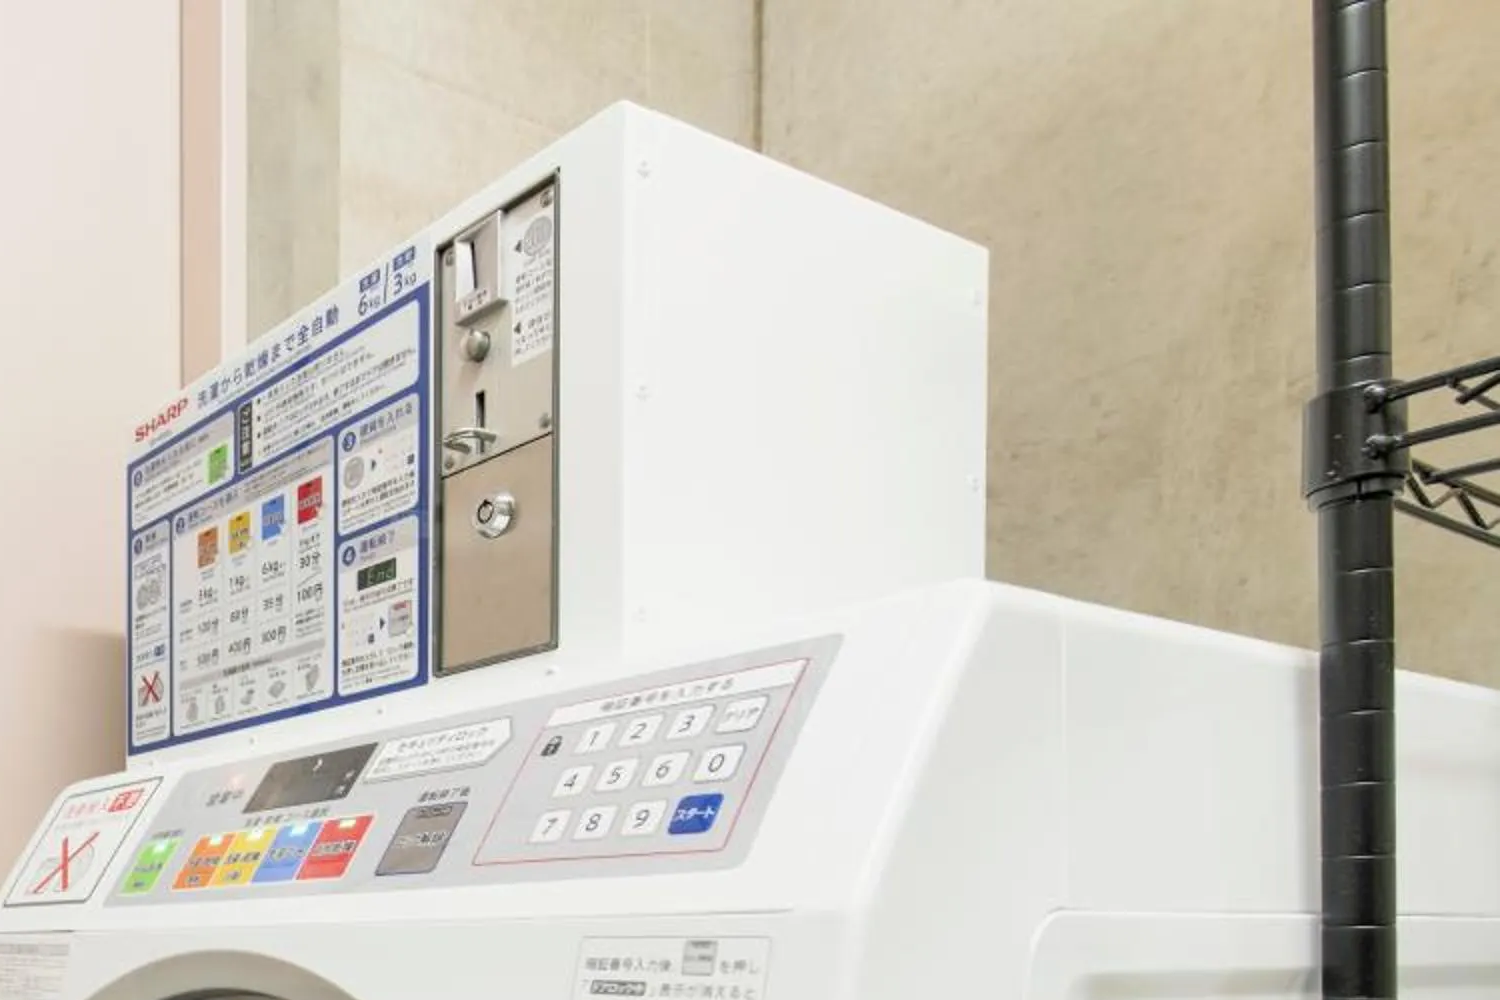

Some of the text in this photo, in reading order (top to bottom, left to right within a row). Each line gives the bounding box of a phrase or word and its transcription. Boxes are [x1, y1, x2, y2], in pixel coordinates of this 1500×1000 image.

[197, 304, 340, 409] 洗濯から乾燥まで全自動
[133, 397, 189, 443] SHARP
[588, 715, 695, 747] 1 2 3
[563, 752, 725, 790] 4 5 6 0
[542, 809, 651, 836] 7 8 9
[675, 805, 715, 821] スタート
